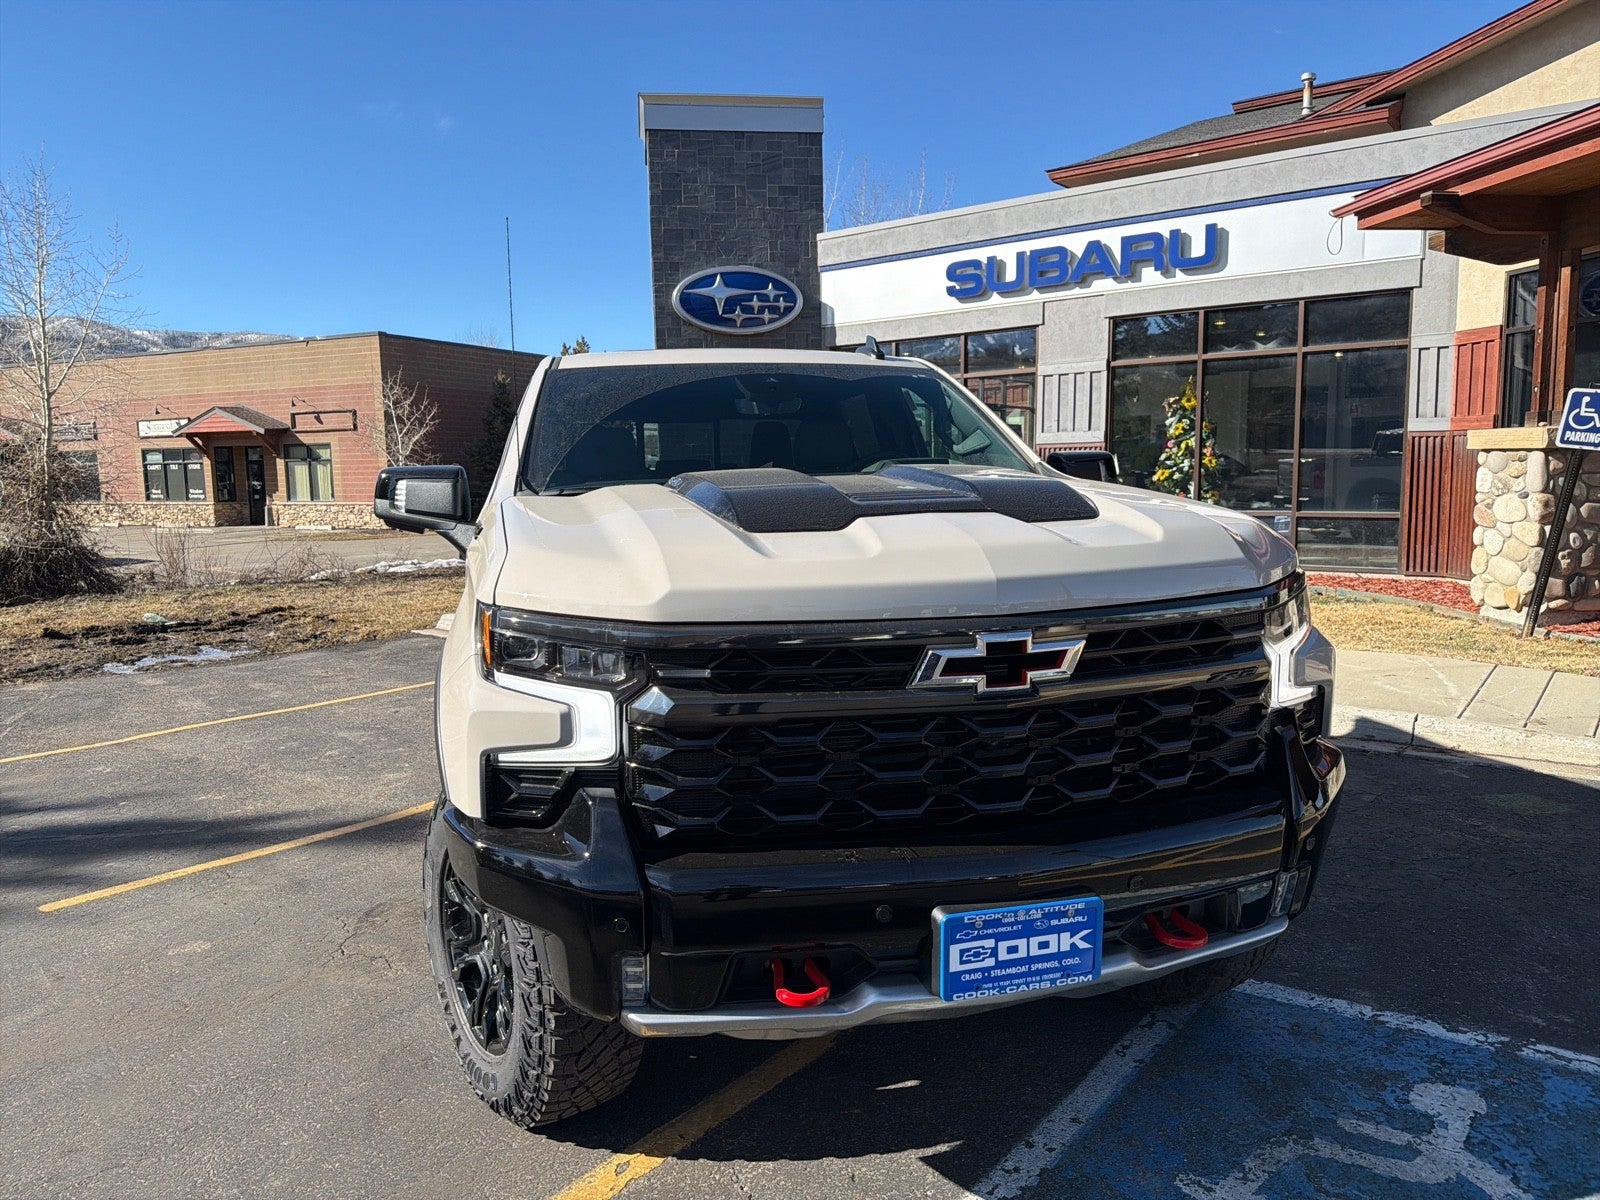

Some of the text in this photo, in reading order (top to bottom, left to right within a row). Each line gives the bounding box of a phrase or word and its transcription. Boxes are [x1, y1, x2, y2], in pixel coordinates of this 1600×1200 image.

[946, 223, 1218, 298] SUBARU
[1029, 902, 1086, 915] ALTITUDE
[979, 924, 1023, 935] CHEVROLET
[1050, 915, 1088, 926] SUBARU
[949, 929, 1094, 973] COOK
[961, 972, 983, 982] CRAIG
[990, 964, 1029, 978] STEAMBOAT
[952, 974, 1093, 1001] COOK-CARS.COM
